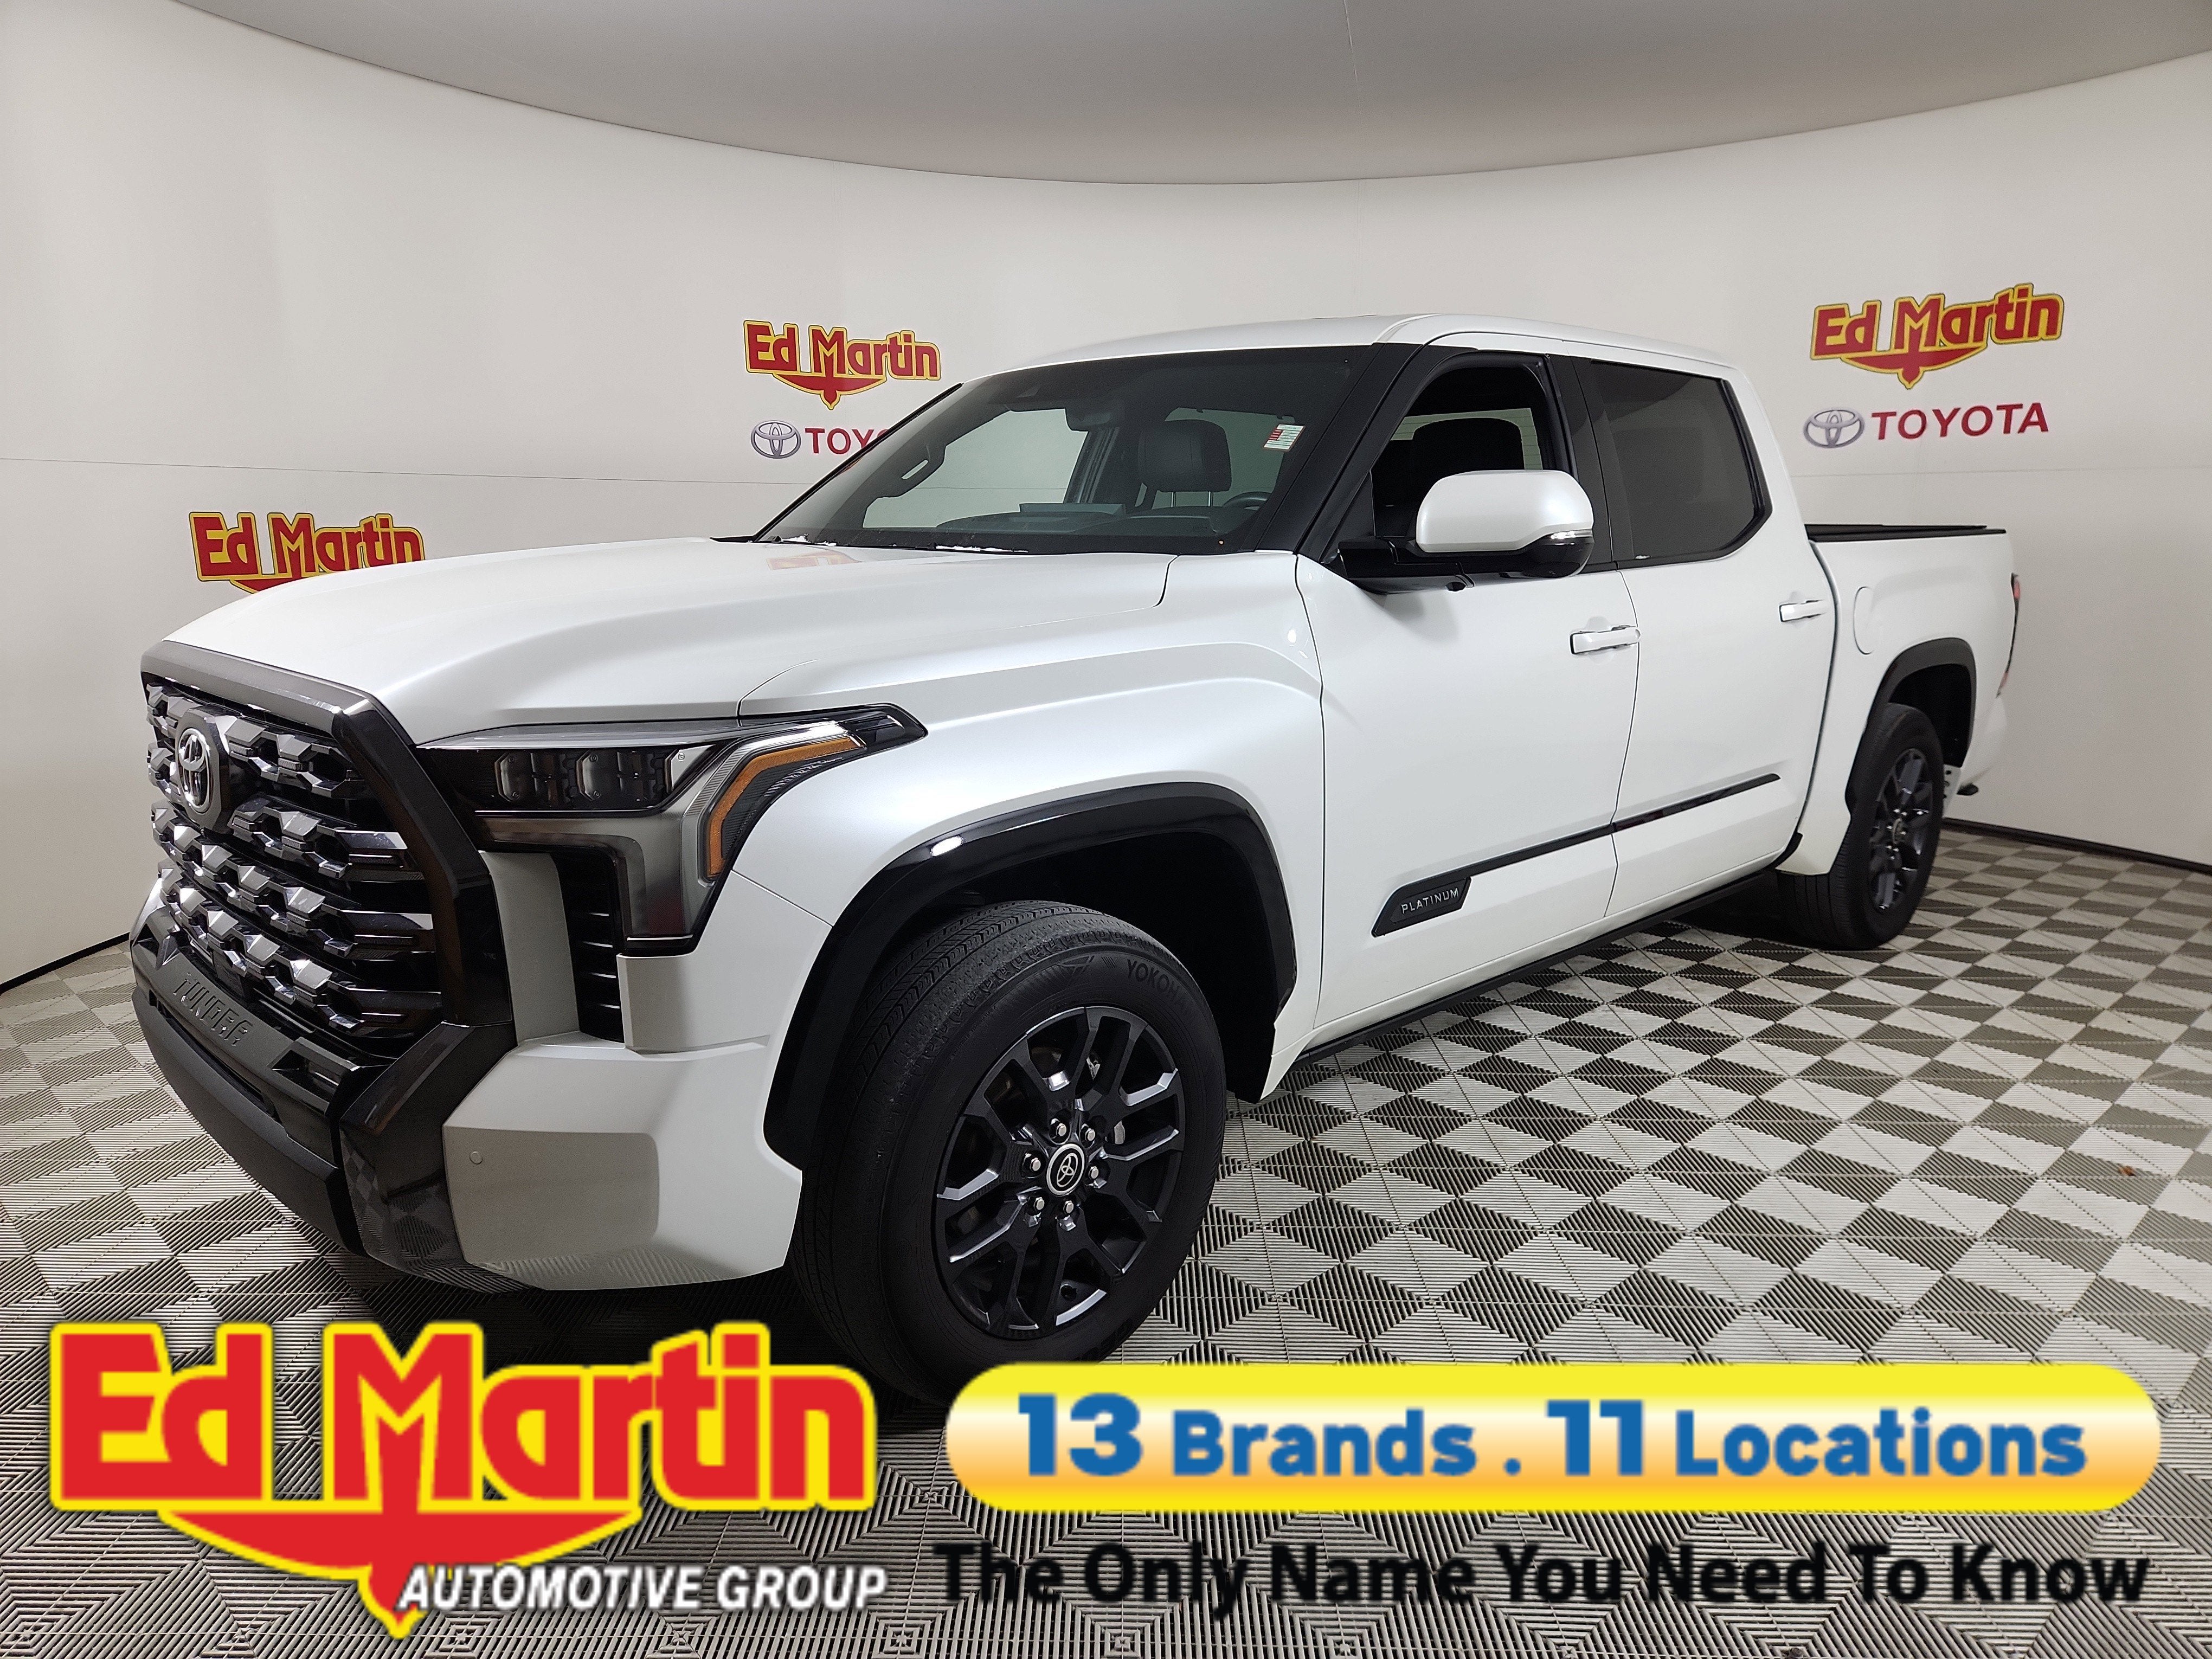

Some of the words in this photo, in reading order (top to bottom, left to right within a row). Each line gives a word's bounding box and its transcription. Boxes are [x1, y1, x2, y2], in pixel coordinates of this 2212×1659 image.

[1813, 303, 1878, 356] Ed
[1893, 286, 2062, 350] Martin
[745, 322, 800, 372] Ed
[809, 326, 940, 378] Martin
[805, 428, 889, 454] TOY
[1871, 402, 2049, 440] TOYOTA
[191, 516, 260, 577] Ed
[269, 516, 423, 576] Martin
[1401, 888, 1459, 914] PLATINUM
